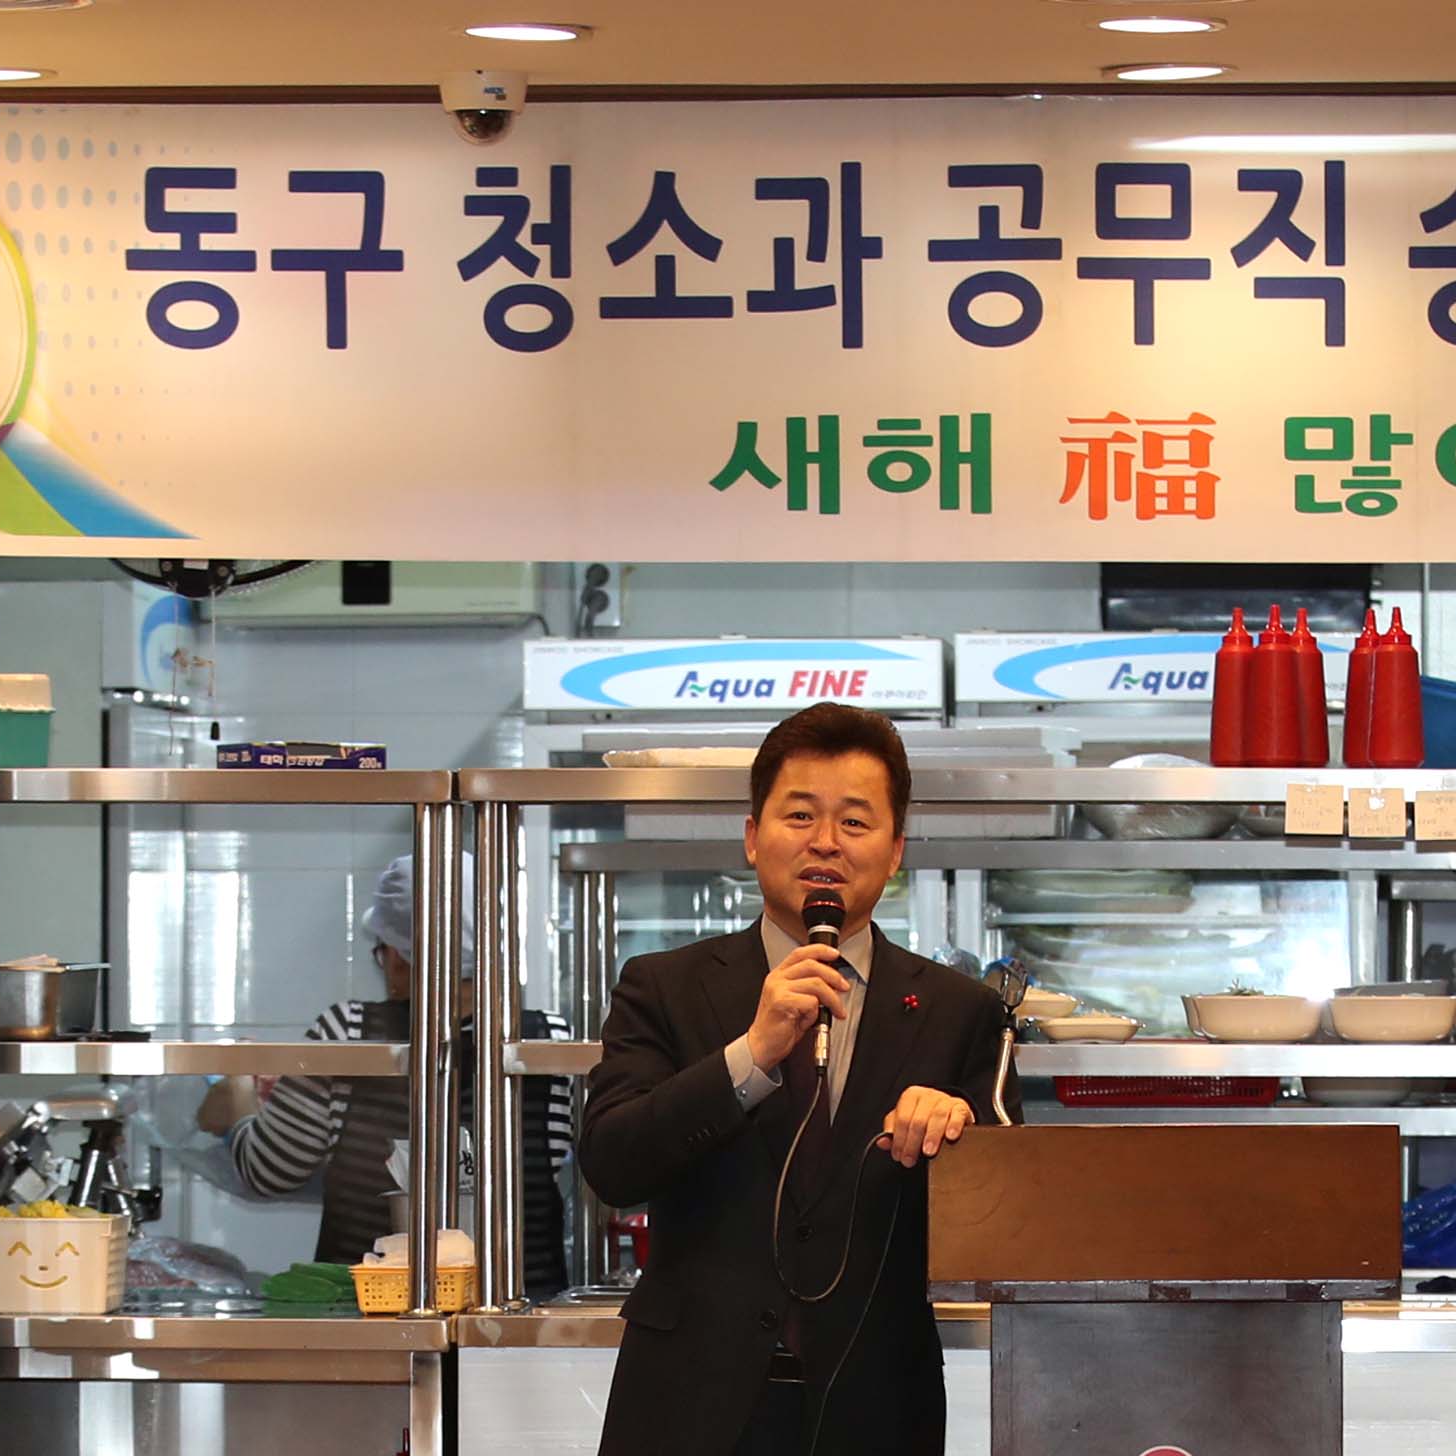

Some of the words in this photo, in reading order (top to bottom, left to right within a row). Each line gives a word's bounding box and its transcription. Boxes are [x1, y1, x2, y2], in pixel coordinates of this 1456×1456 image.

[124, 165, 405, 351] 동구
[456, 163, 883, 352] 청소과
[927, 161, 1347, 349] 공무직
[710, 412, 993, 515] 새해
[1059, 412, 1222, 522] 福
[675, 670, 775, 703] Aqua
[788, 670, 869, 698] FINE
[1107, 662, 1211, 695] Aqua
